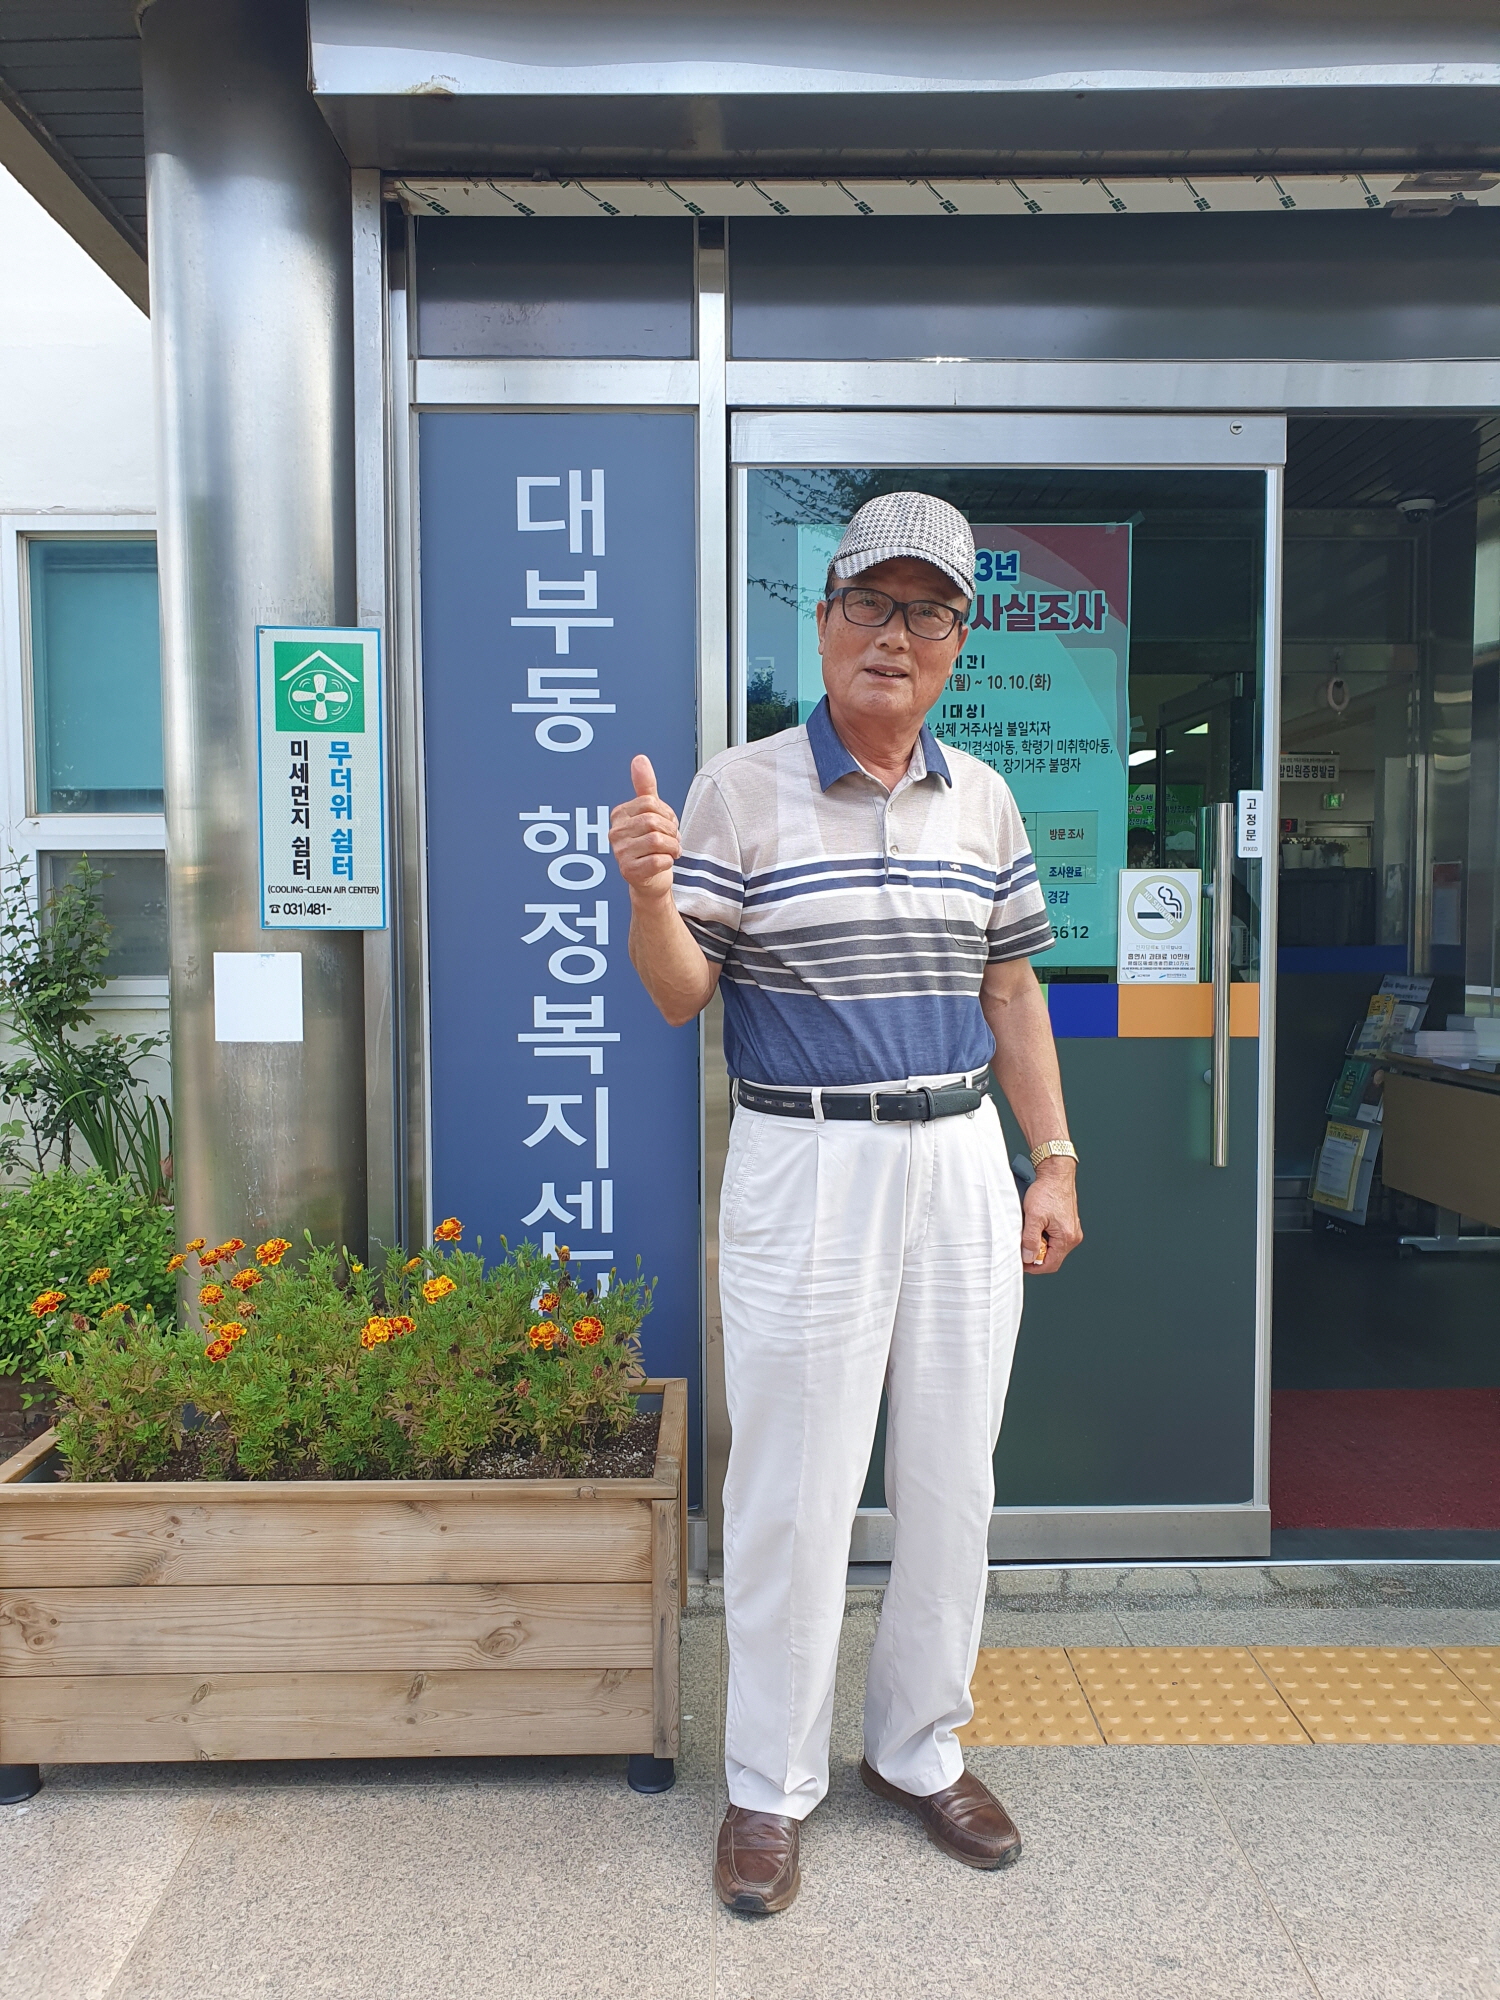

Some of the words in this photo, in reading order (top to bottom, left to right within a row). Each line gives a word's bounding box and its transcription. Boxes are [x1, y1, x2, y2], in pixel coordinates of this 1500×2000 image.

[510, 469, 616, 752] 대부동
[970, 594, 1105, 631] 사실조사
[935, 722, 956, 738] 실제
[960, 722, 1002, 737] 거주사실
[1007, 721, 1050, 736] 불일치자
[1022, 740, 1053, 754] 학령기
[1057, 739, 1113, 754] 미취학아동,
[1003, 758, 1046, 774] 장기거주
[1049, 758, 1081, 773] 불명자
[289, 740, 310, 830] 미세먼지
[328, 741, 352, 820] 무더위
[1246, 798, 1256, 841] 고정문
[1050, 828, 1066, 840] 방문
[1068, 828, 1084, 840] 조사
[292, 837, 310, 880] 쉼터
[330, 828, 353, 880] 쉼터
[1049, 866, 1082, 878] 조사완료
[268, 885, 331, 894] (COOLING-CLEAN
[334, 886, 346, 894] AIR
[348, 886, 380, 894] CENTER)
[1048, 891, 1070, 904] 경감
[283, 902, 332, 916] 031)481-
[1152, 900, 1175, 924] SMOKING
[518, 806, 621, 1316] 행정복지센
